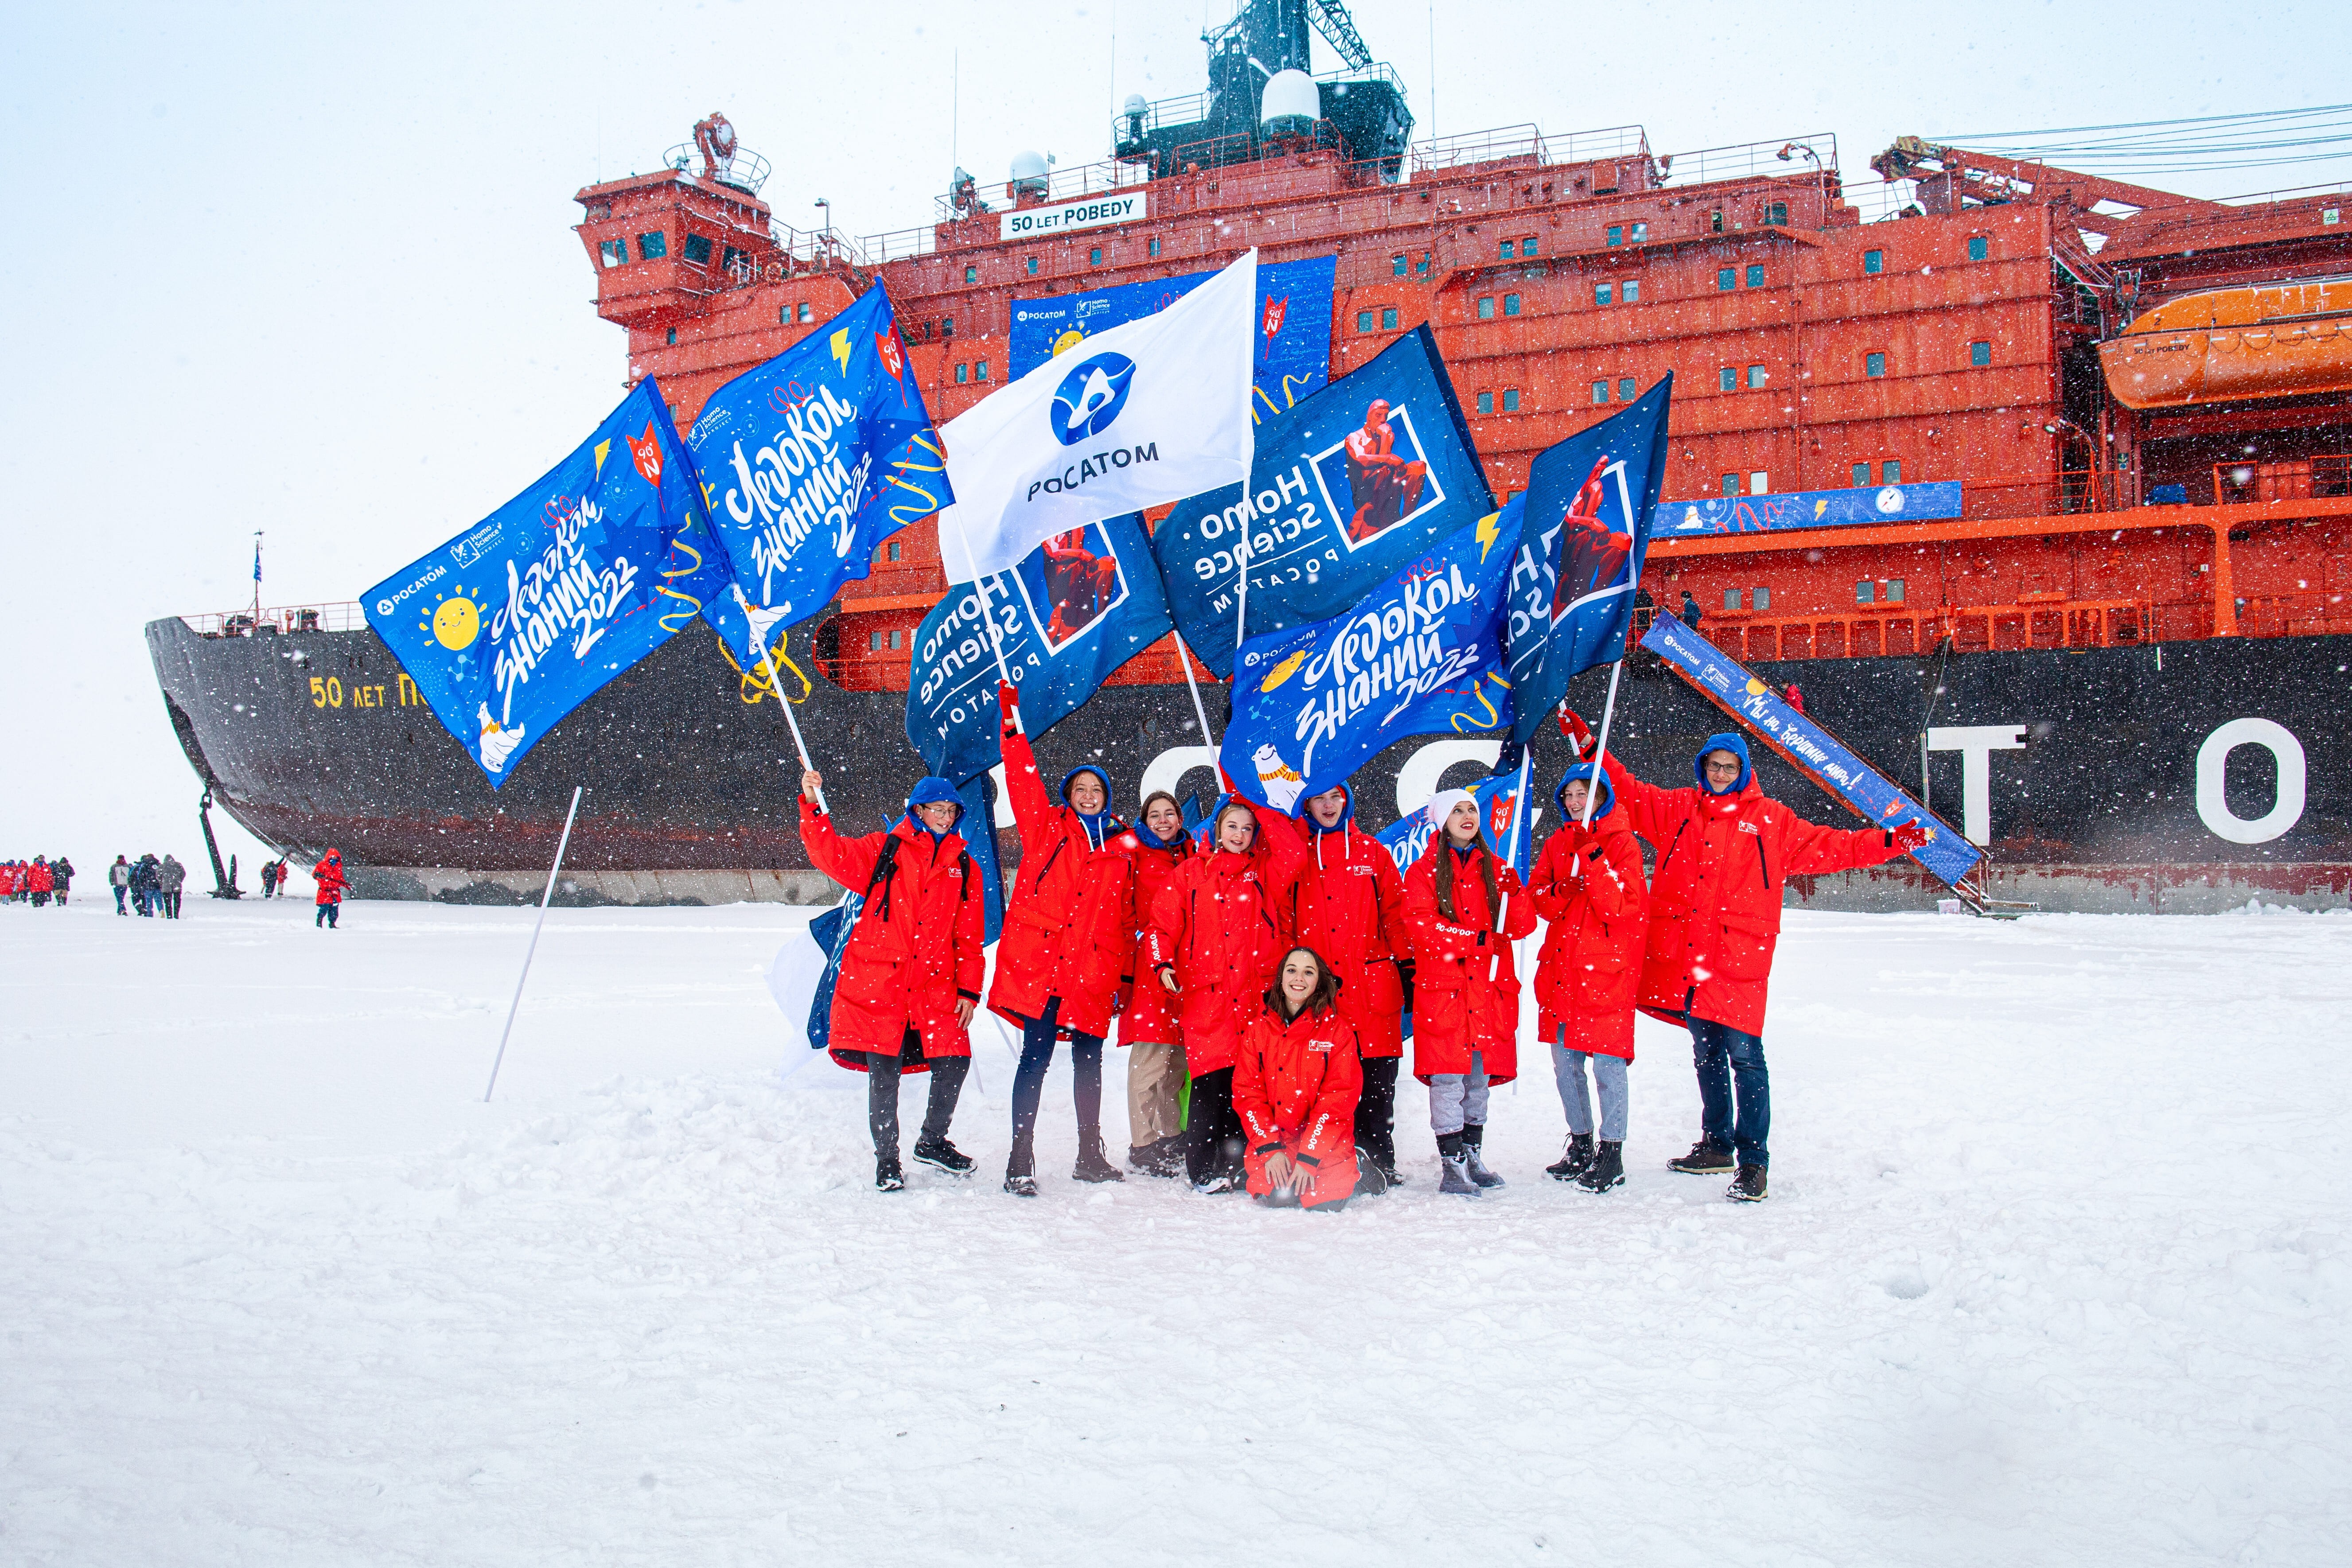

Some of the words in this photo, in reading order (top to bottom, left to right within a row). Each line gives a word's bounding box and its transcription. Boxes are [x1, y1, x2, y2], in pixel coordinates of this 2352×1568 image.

[1012, 216, 1032, 232] 50
[1037, 215, 1059, 228] LET
[1064, 199, 1133, 224] POBEDY
[1028, 310, 1066, 319] РОСАТОМ
[1266, 319, 1278, 332] N
[2157, 344, 2190, 353] POBEDY
[889, 356, 902, 373] N
[701, 407, 720, 425] Homo
[705, 409, 727, 429] Science
[643, 459, 660, 478] N
[1027, 442, 1160, 502] РОСАТОМ
[825, 451, 872, 558] 2022
[470, 525, 492, 543] Homo
[475, 528, 499, 548] Science
[481, 537, 505, 556] PROJECT
[392, 565, 447, 605] РОСАТОМ
[571, 556, 639, 660] 2022
[1671, 642, 1701, 666] РОСАТОМ
[1381, 643, 1479, 727] 2022
[1715, 676, 1729, 689] Science
[1717, 672, 1730, 684] Homo
[310, 676, 342, 708] 50
[354, 685, 385, 708] ЛЕТ
[1743, 696, 1768, 720] Мы
[1764, 716, 1780, 731] на
[1823, 763, 1864, 790] мира!
[1495, 806, 1509, 817] 90°
[1495, 817, 1506, 831] N
